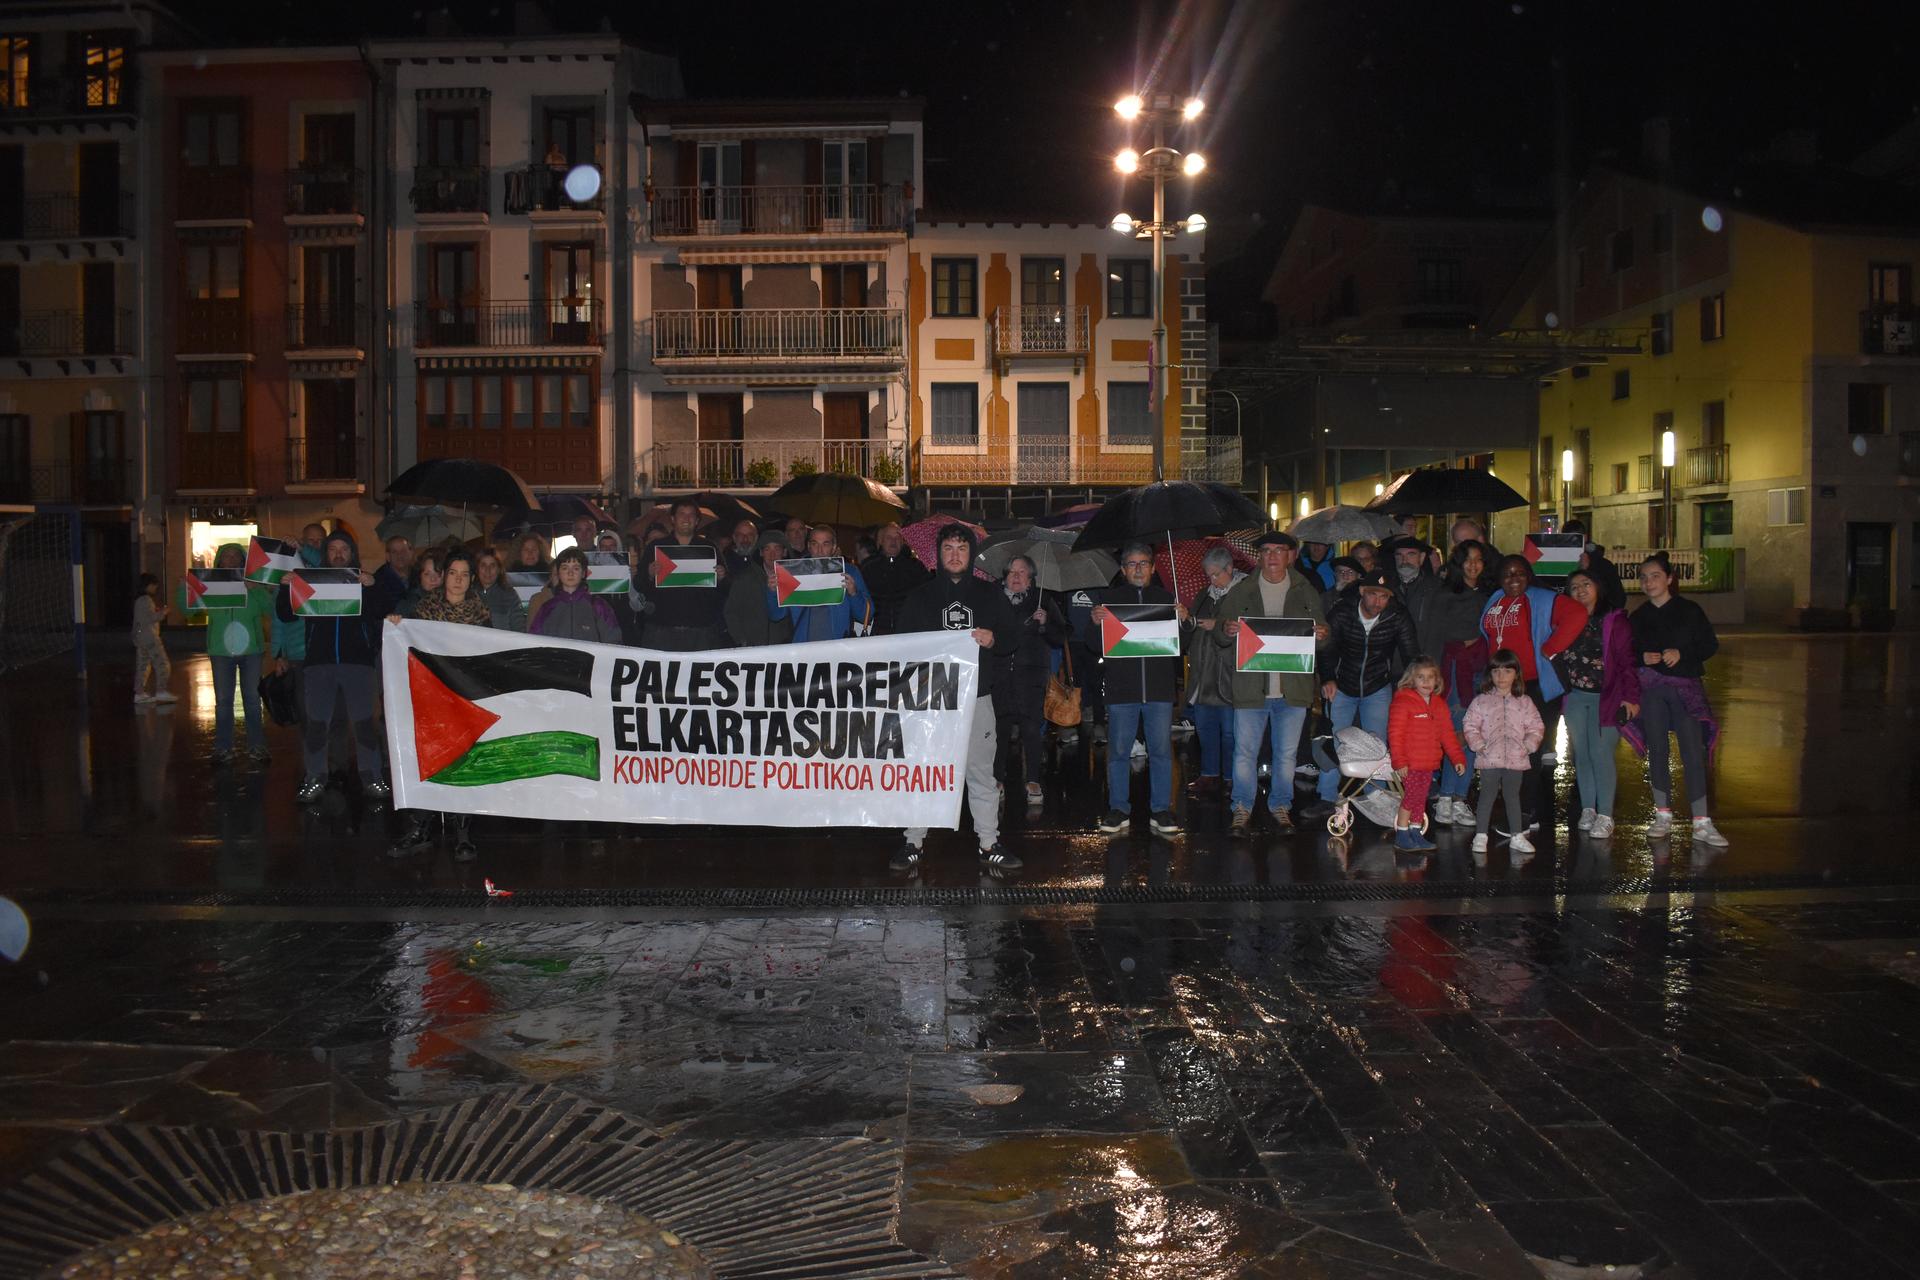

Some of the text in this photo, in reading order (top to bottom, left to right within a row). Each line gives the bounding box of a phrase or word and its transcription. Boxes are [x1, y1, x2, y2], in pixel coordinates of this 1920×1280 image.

[611, 658, 960, 711] PALESTINAREKIN
[612, 706, 905, 760] ELKARTASUNA
[613, 754, 955, 793] KONPONBIDE POLITIKOA ORAIN!
